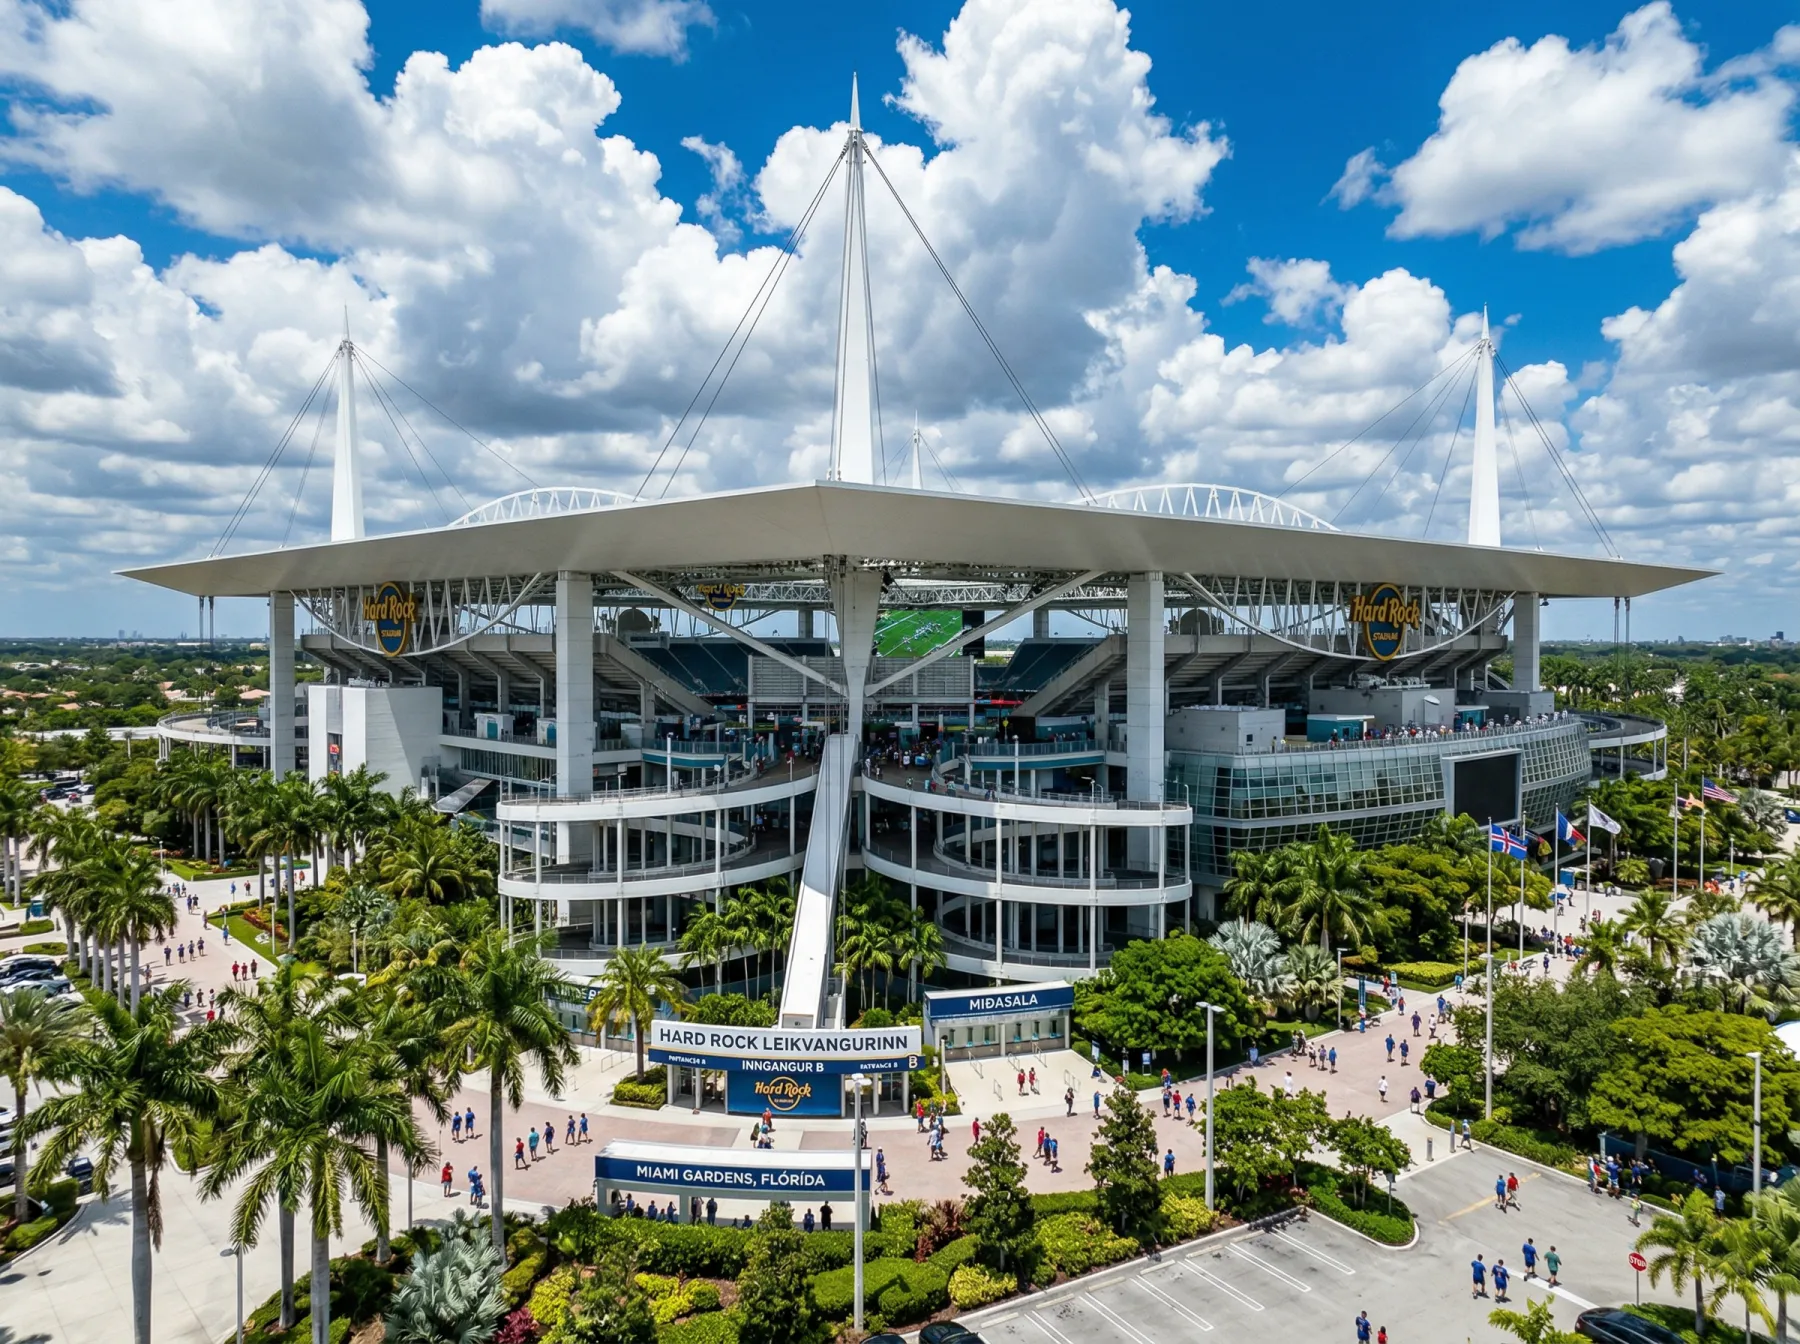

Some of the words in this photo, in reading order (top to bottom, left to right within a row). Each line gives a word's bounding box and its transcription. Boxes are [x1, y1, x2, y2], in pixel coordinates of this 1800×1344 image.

[363, 595, 388, 620] Hard
[389, 592, 415, 625] Rock
[1353, 595, 1389, 622] Hard
[1389, 598, 1420, 628] Rock
[969, 993, 1039, 1011] MIÐASALA
[660, 1027, 706, 1046] HARD
[710, 1033, 759, 1050] ROCK
[763, 1035, 908, 1052] LEIKVANGURINN
[742, 1060, 813, 1073] INNGANGUR
[816, 1062, 825, 1073] B
[908, 1055, 918, 1069] B
[754, 1081, 783, 1095] Hard
[784, 1082, 811, 1098] Rock
[636, 1165, 679, 1181] MIAMI
[682, 1168, 757, 1188] GARDENS,
[761, 1170, 826, 1187] FLÓRÍDA
